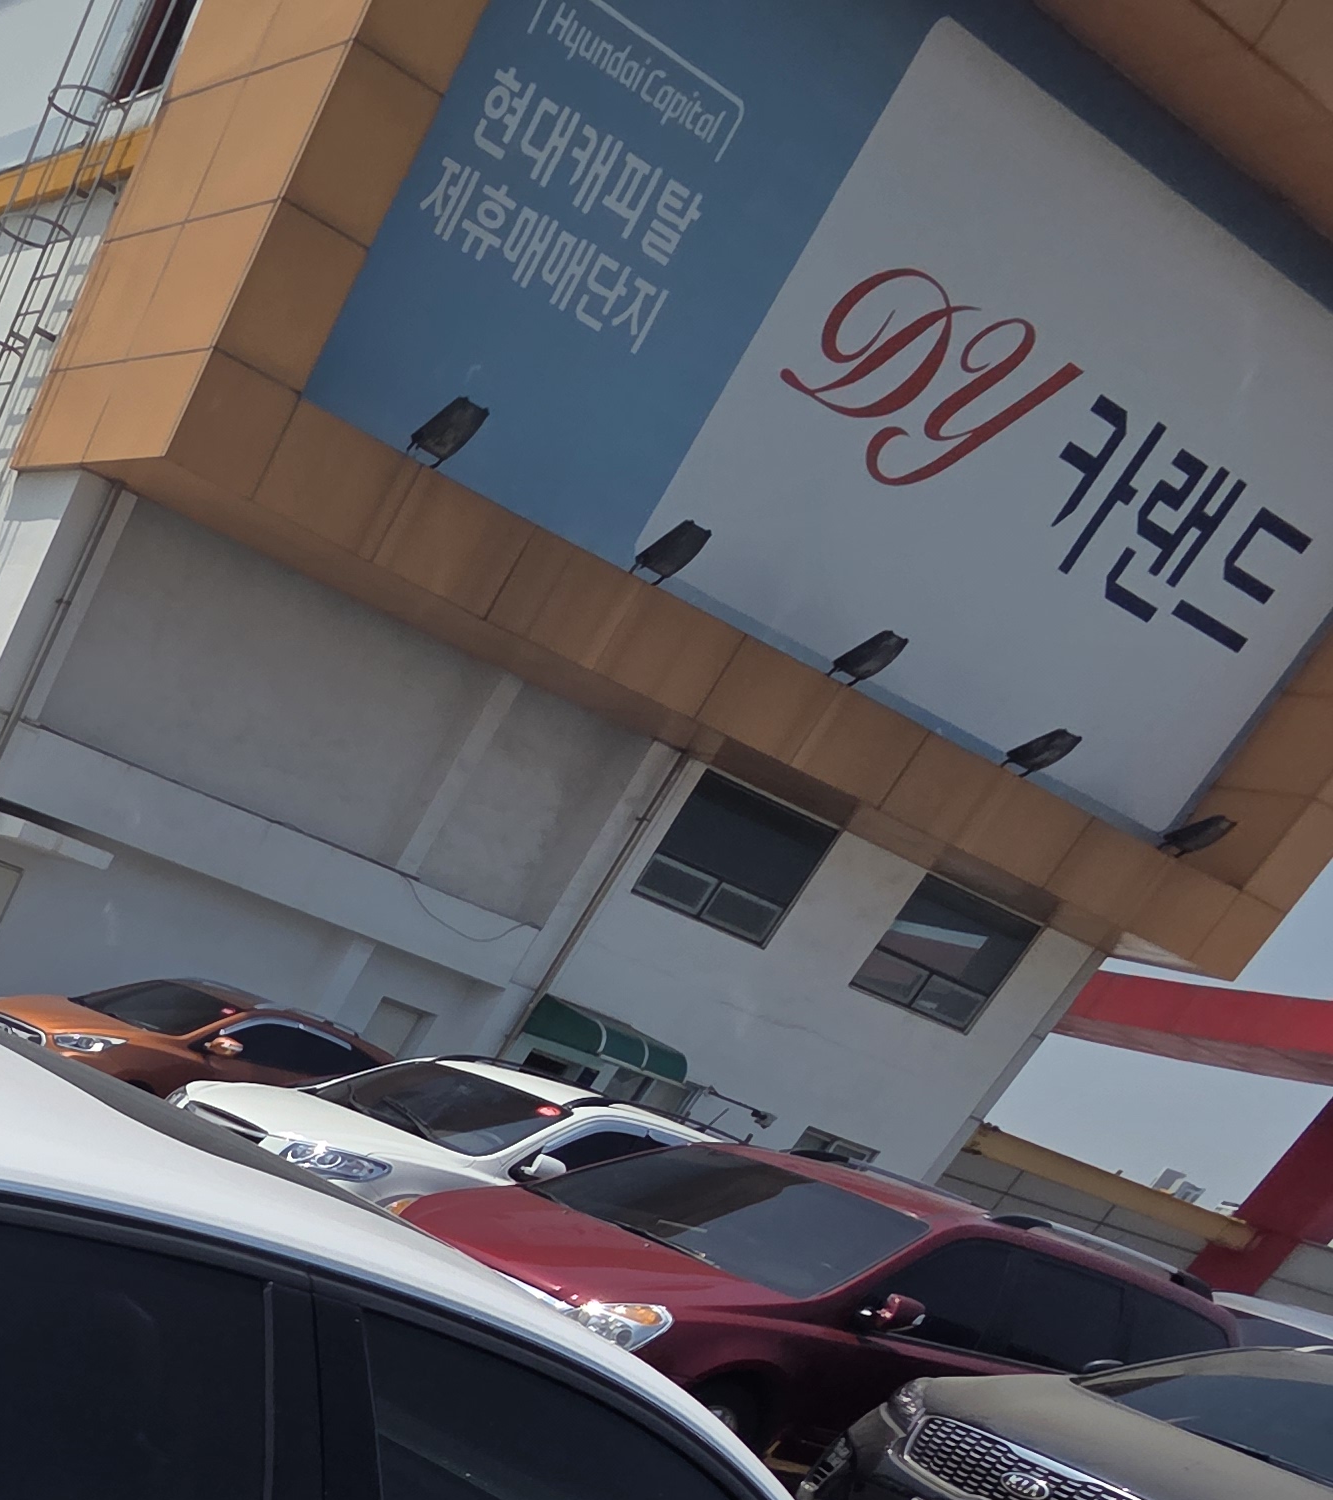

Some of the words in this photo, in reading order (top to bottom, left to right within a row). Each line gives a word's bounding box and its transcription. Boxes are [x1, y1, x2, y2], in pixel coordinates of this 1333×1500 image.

[474, 66, 703, 267] 현대캐피탈
[547, 1, 651, 91] Hyundai
[639, 68, 727, 144] Capital
[419, 156, 670, 355] 제휴매매단지
[779, 267, 1085, 487] DY
[1050, 393, 1313, 654] 카랜드
[1005, 1474, 1040, 1497] KIA
